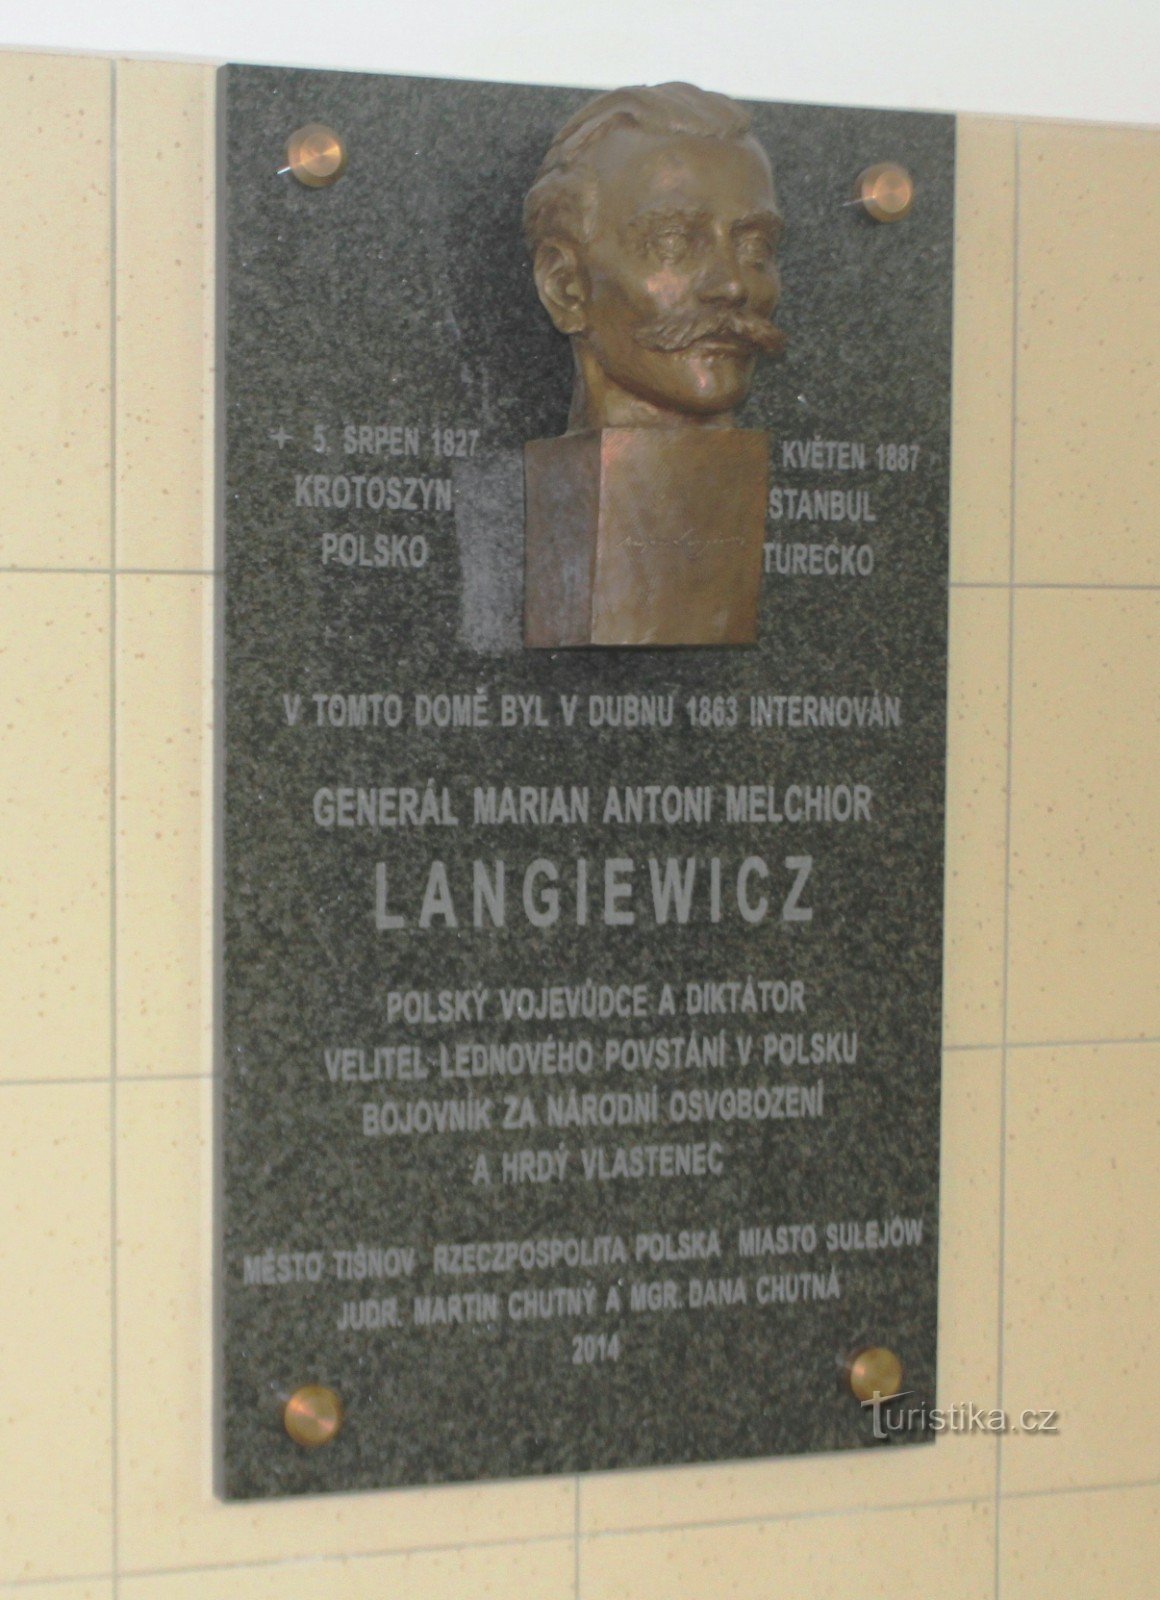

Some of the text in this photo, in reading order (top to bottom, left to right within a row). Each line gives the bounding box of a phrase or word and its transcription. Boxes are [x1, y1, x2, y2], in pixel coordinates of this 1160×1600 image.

[344, 425, 419, 455] SRPEN
[431, 429, 480, 457] 1827
[876, 444, 920, 471] 1887
[294, 474, 452, 511] KROTOSZYN
[769, 486, 876, 521] STANBUL
[322, 532, 429, 568] POLSKO
[283, 694, 300, 726] V
[312, 694, 403, 727] TOMTO
[501, 694, 548, 726] BYL
[560, 695, 578, 726] V
[589, 695, 674, 727] DUBNU
[686, 695, 738, 727] 1863
[750, 690, 901, 727] INTERNOVÁN
[312, 777, 872, 826] GENERÁL MARIAN ANTONI MELCHIOR
[376, 855, 813, 929] LANGIEWICZ
[387, 981, 488, 1024] POLSKÝ
[658, 983, 676, 1016] A
[686, 974, 806, 1015] DIKTÁTOR
[324, 1028, 858, 1081] VELITEL LEDNOVÉHO POVSTÁNÍ V POLSKU
[363, 1078, 824, 1136] BOJOVNÍK ZA NÁRODNÍ OSVOBOZENÍ
[472, 1142, 723, 1186] A HRDÝ VLASTENEC
[433, 1235, 626, 1275] RZECZPOSPOLITA
[739, 1223, 817, 1257] MIASTO
[414, 1293, 499, 1325] MARTIN
[508, 1280, 597, 1320] CHUTNÝ
[605, 1286, 621, 1313] A
[689, 1277, 747, 1308] DANA
[756, 1264, 840, 1305] CHUTNÁ
[572, 1333, 620, 1365] 2014
